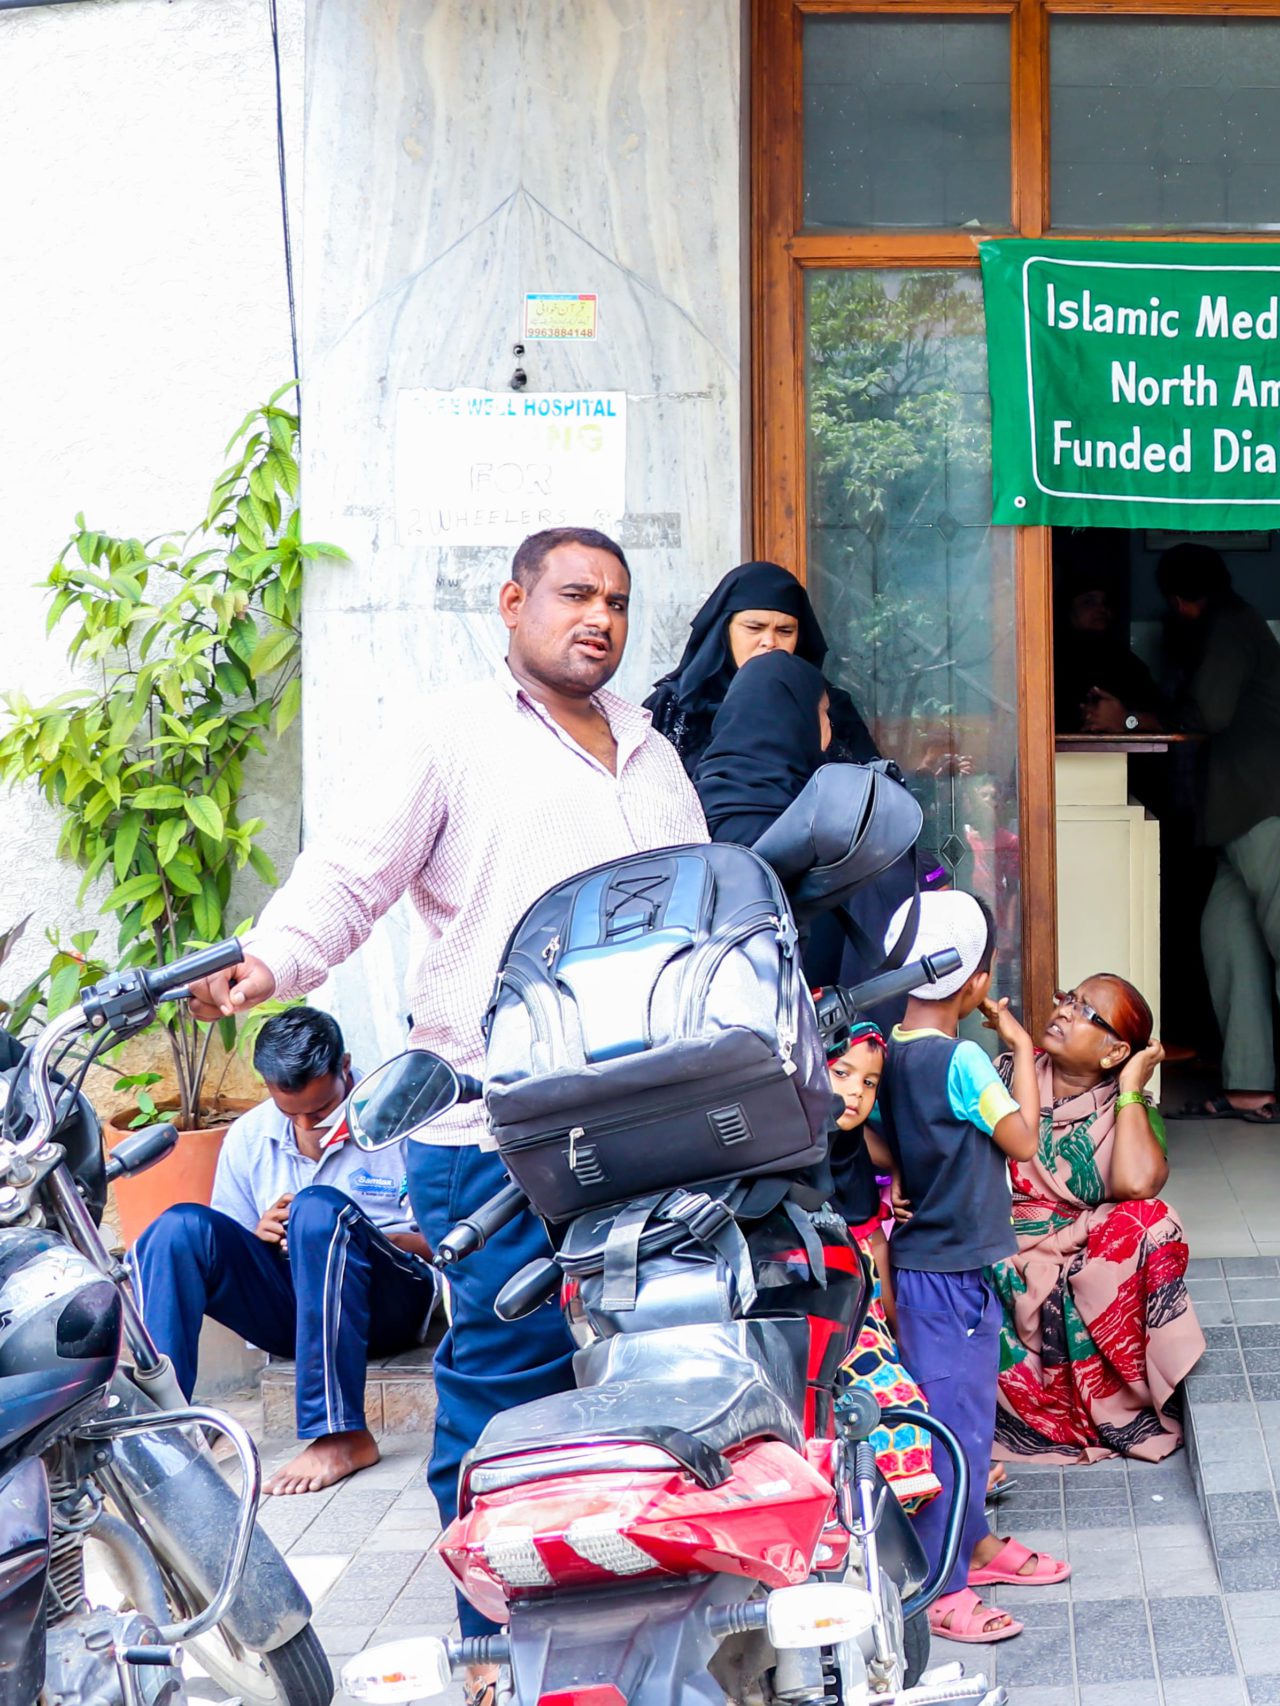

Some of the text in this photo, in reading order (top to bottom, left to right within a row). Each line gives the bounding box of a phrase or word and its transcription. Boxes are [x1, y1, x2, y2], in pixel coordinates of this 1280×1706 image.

[1046, 283, 1179, 339] Islamic
[524, 398, 616, 416] HOSPITAL
[1110, 360, 1218, 407] North
[1052, 420, 1192, 473] Funded
[469, 461, 553, 496] FOR
